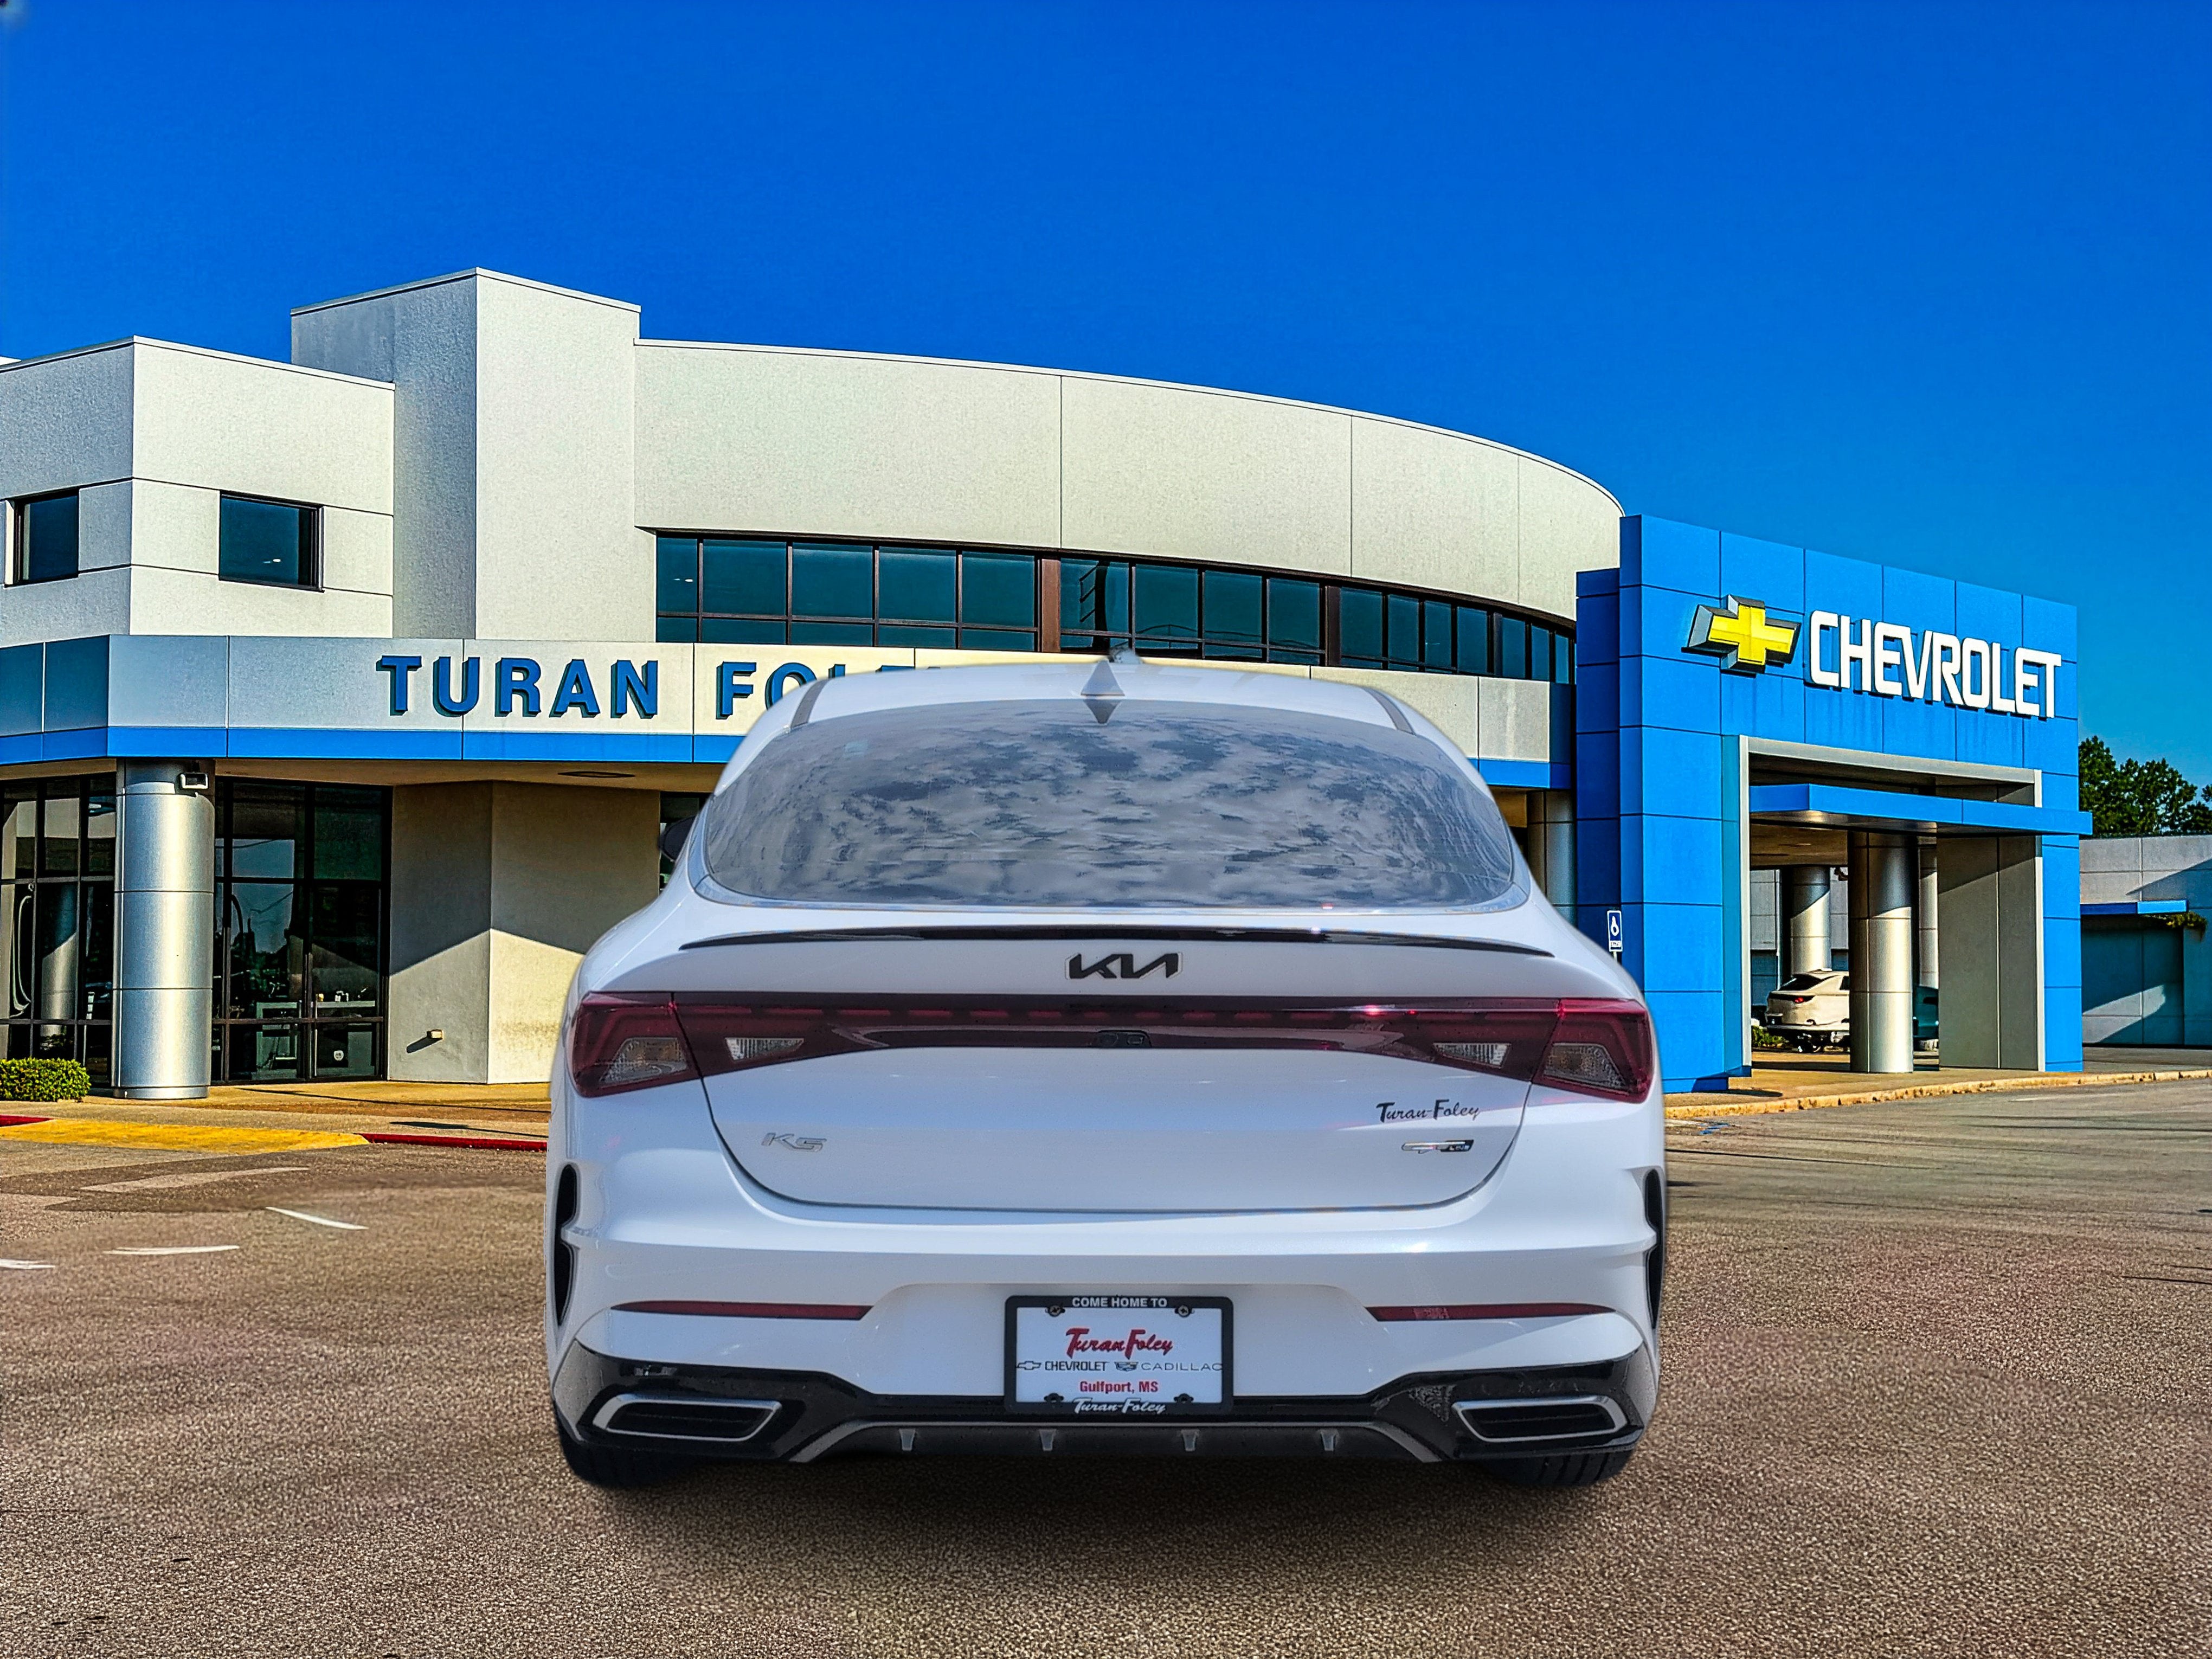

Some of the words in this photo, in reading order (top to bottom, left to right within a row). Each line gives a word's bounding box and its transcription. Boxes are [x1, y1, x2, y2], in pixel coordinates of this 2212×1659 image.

[1810, 609, 2062, 719] CHEVROLET
[376, 655, 659, 719] TURAN
[1072, 1297, 1108, 1308] COME
[1111, 1297, 1148, 1308] HOME
[1152, 1297, 1167, 1308] TO
[1044, 1361, 1109, 1372] CHEVROLET
[1141, 1362, 1224, 1372] CADILLAC
[1079, 1380, 1135, 1394] Gulfport,
[1139, 1381, 1159, 1393] MS
